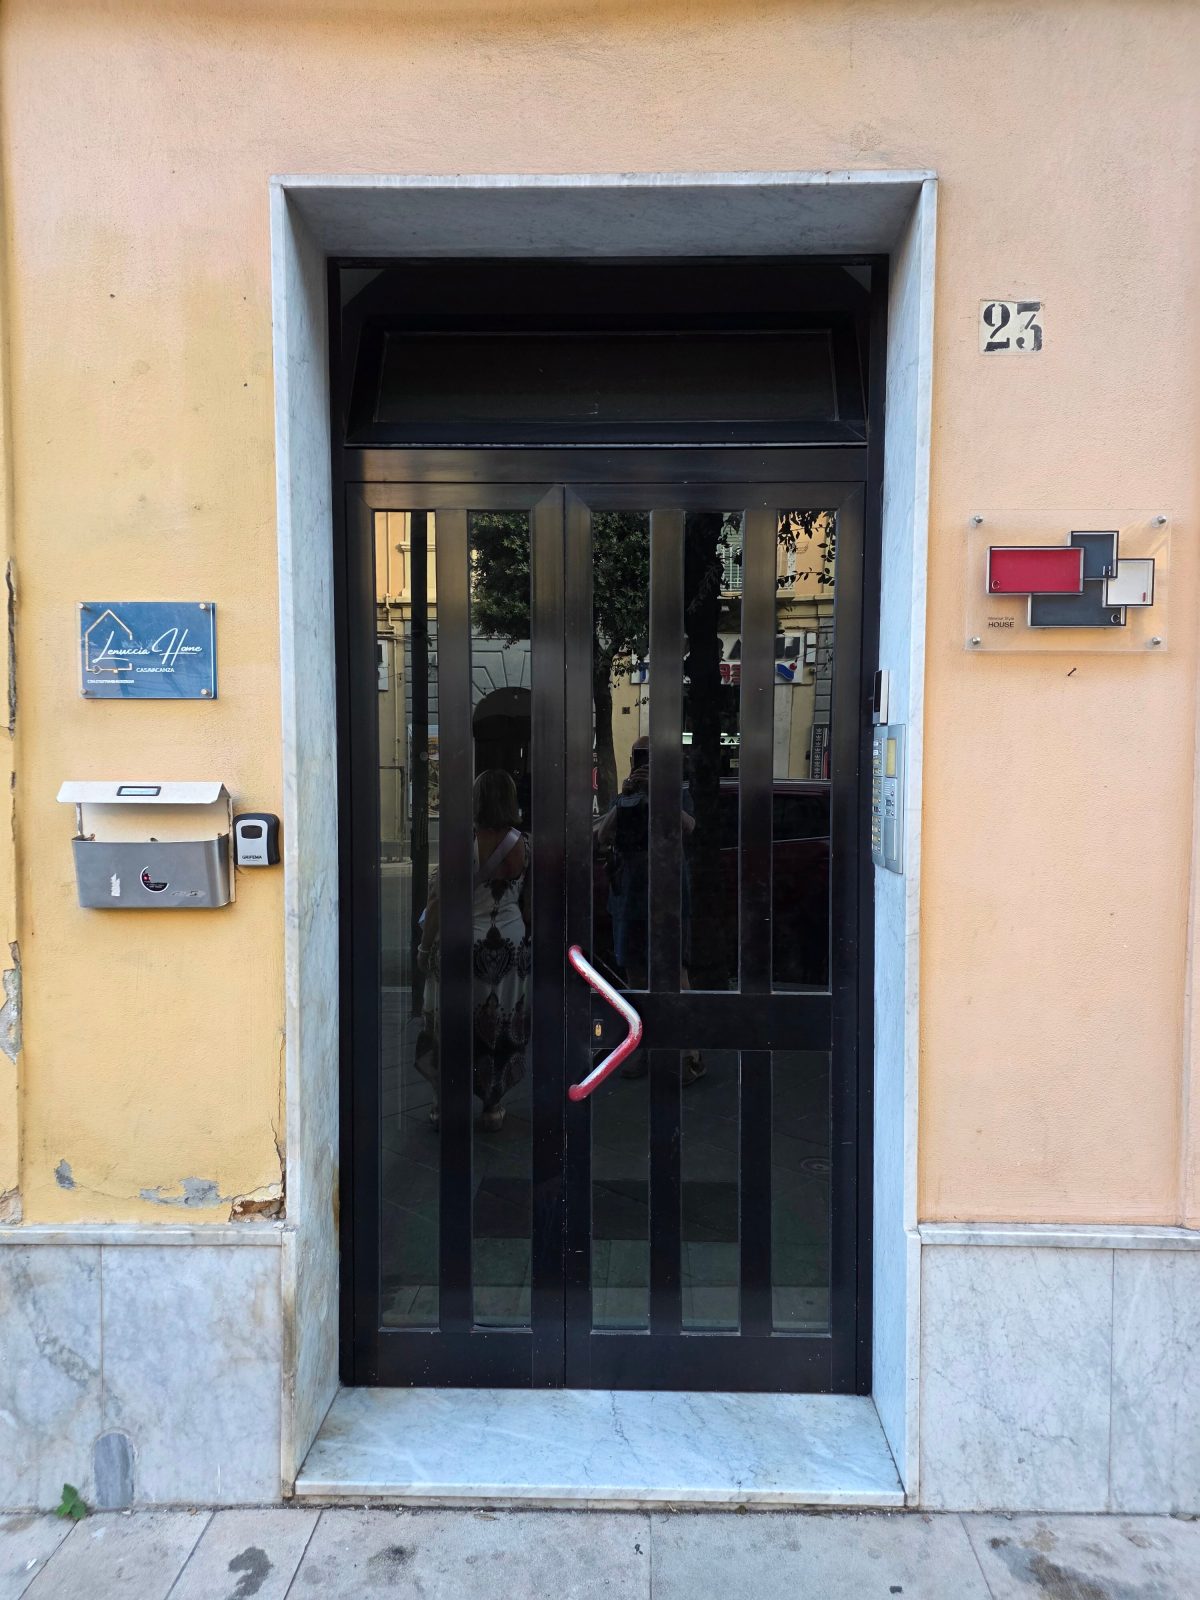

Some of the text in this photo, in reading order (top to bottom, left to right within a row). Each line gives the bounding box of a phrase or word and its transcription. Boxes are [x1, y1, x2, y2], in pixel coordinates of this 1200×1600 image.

[983, 302, 1042, 352] 23
[92, 627, 203, 666] Lenuccia Home
